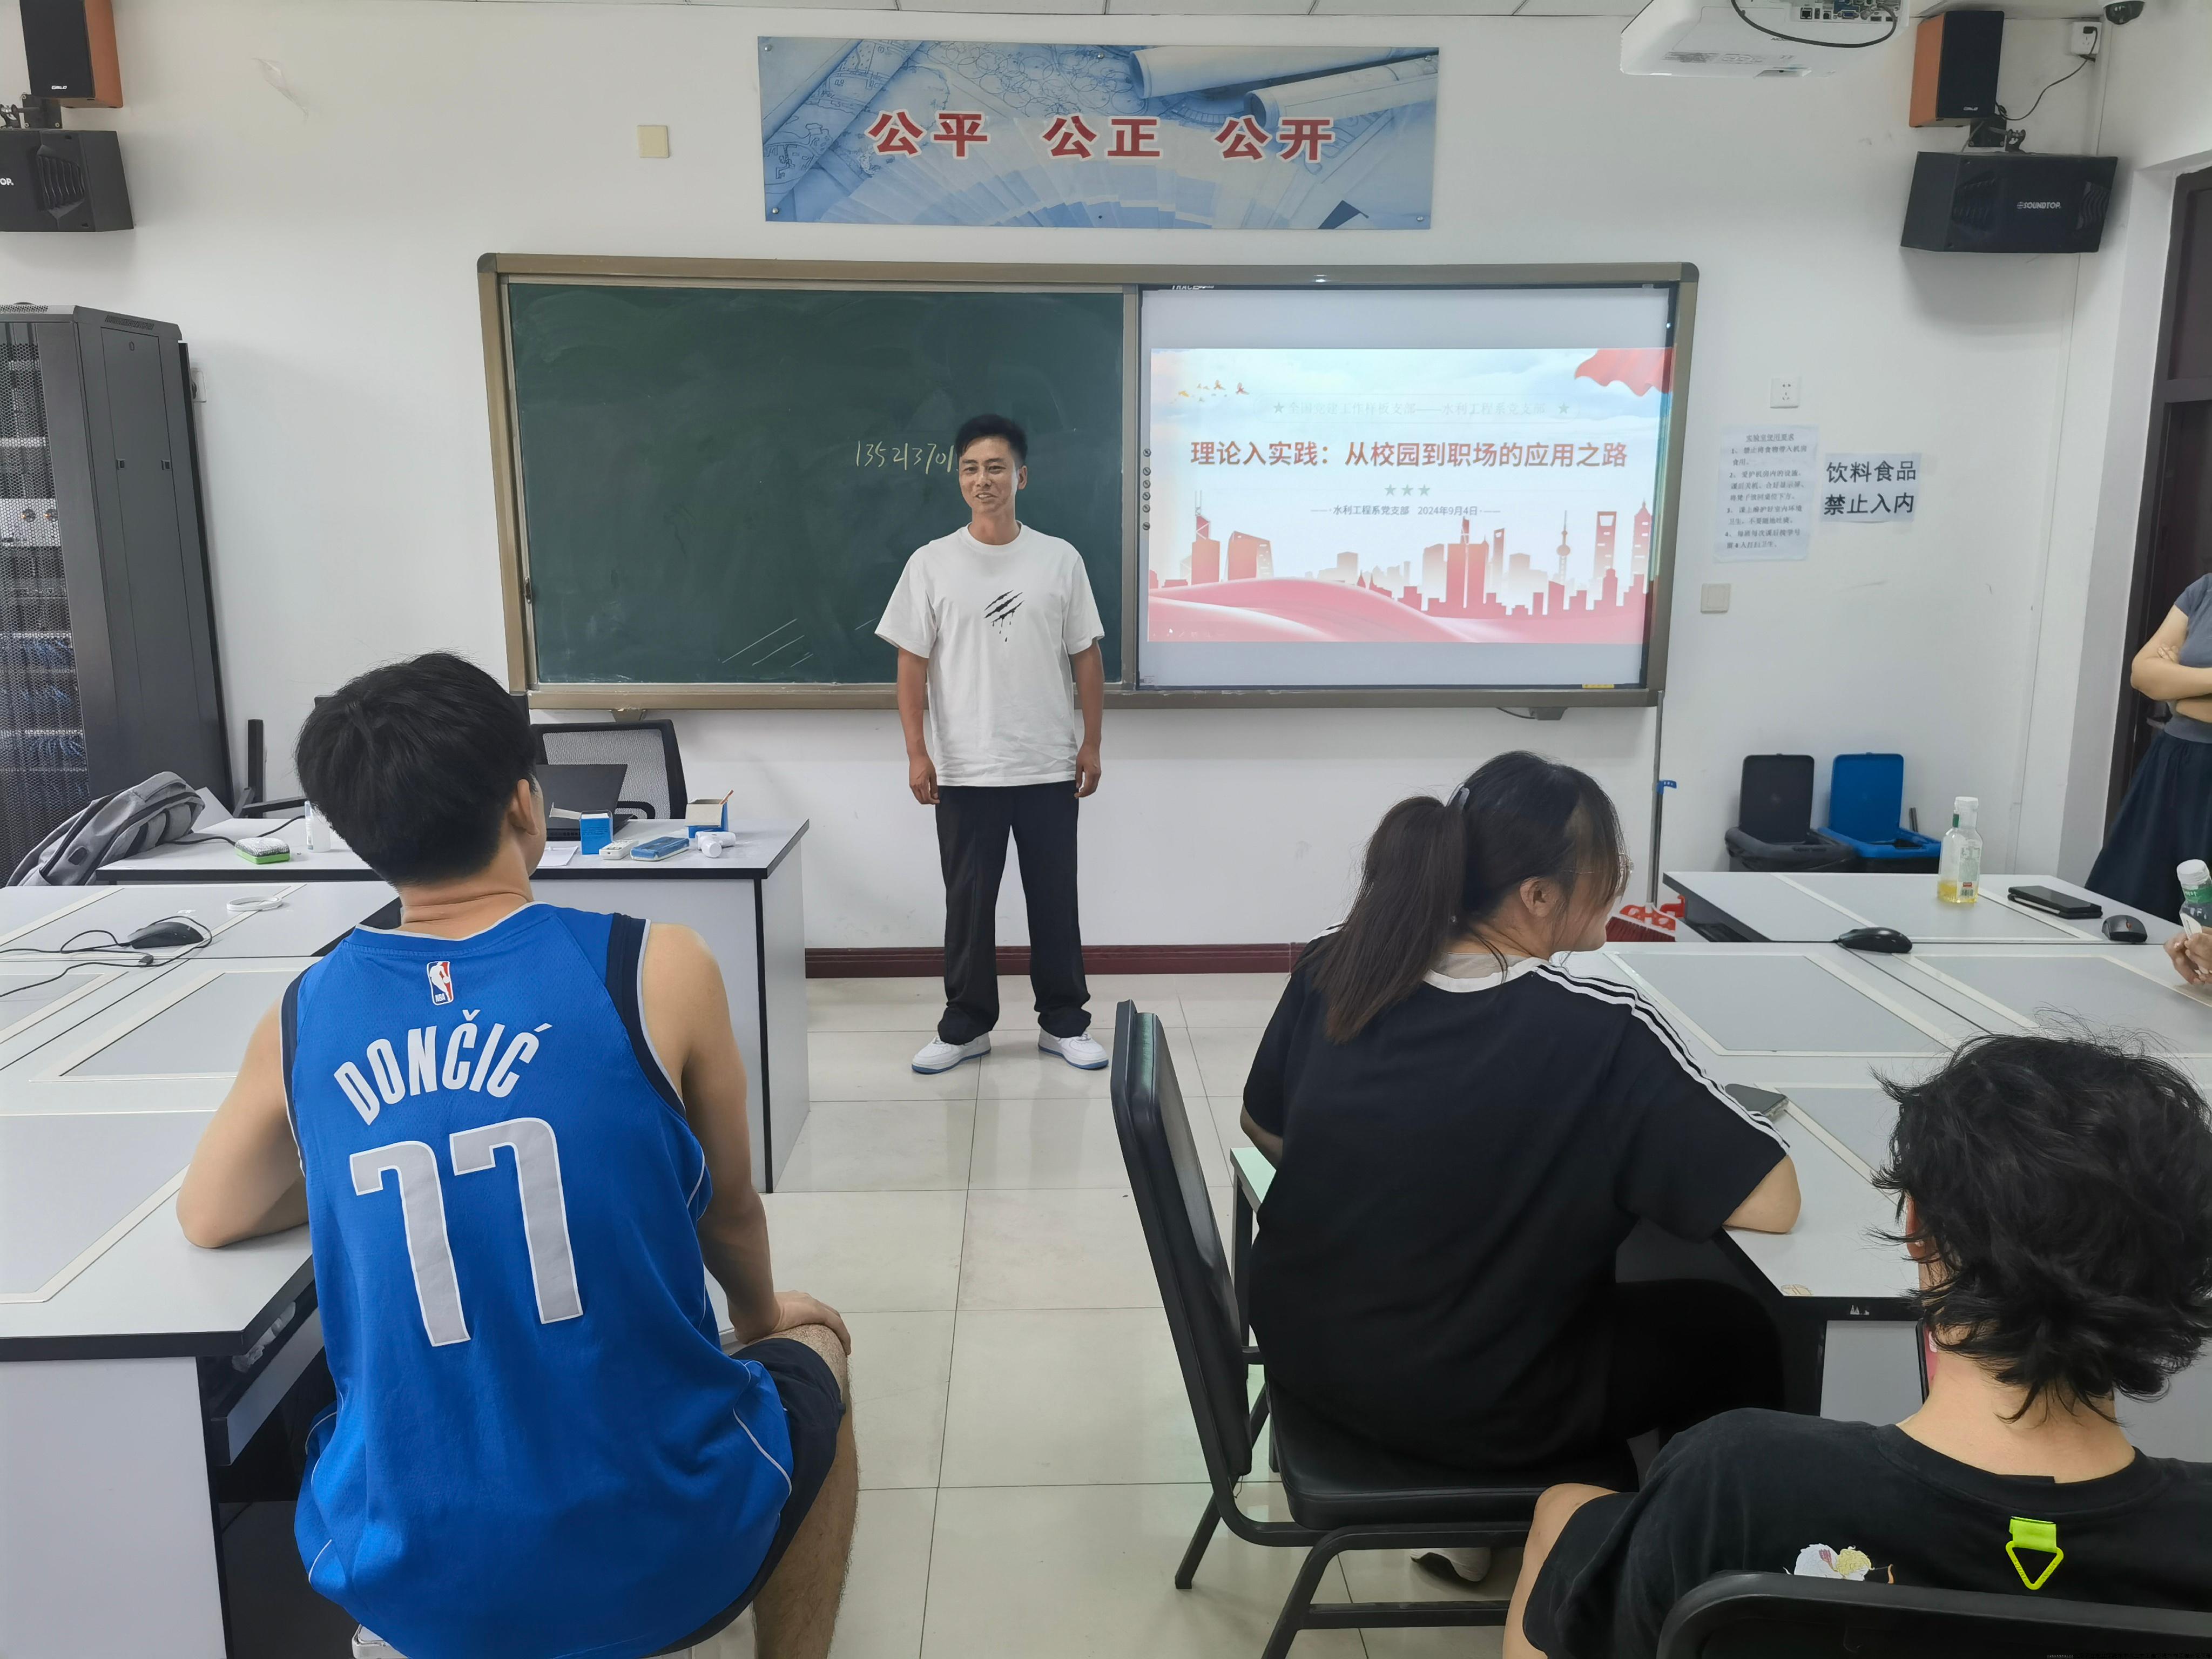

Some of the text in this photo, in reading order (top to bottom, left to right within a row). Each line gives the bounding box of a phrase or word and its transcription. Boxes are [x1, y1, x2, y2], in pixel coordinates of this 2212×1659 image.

[867, 110, 1334, 162] 公平 公正 公开
[856, 441, 956, 475] 135213701
[1189, 440, 1628, 469] 理论入实践：从校园到职场的应用之路
[1826, 460, 1917, 483] 饮料食品
[1332, 505, 1478, 516] 水利工程系党支部 2024年9月4日
[1823, 491, 1915, 516] 禁止入内
[334, 1009, 553, 1125] DONČIĆ
[349, 1117, 584, 1347] 77
